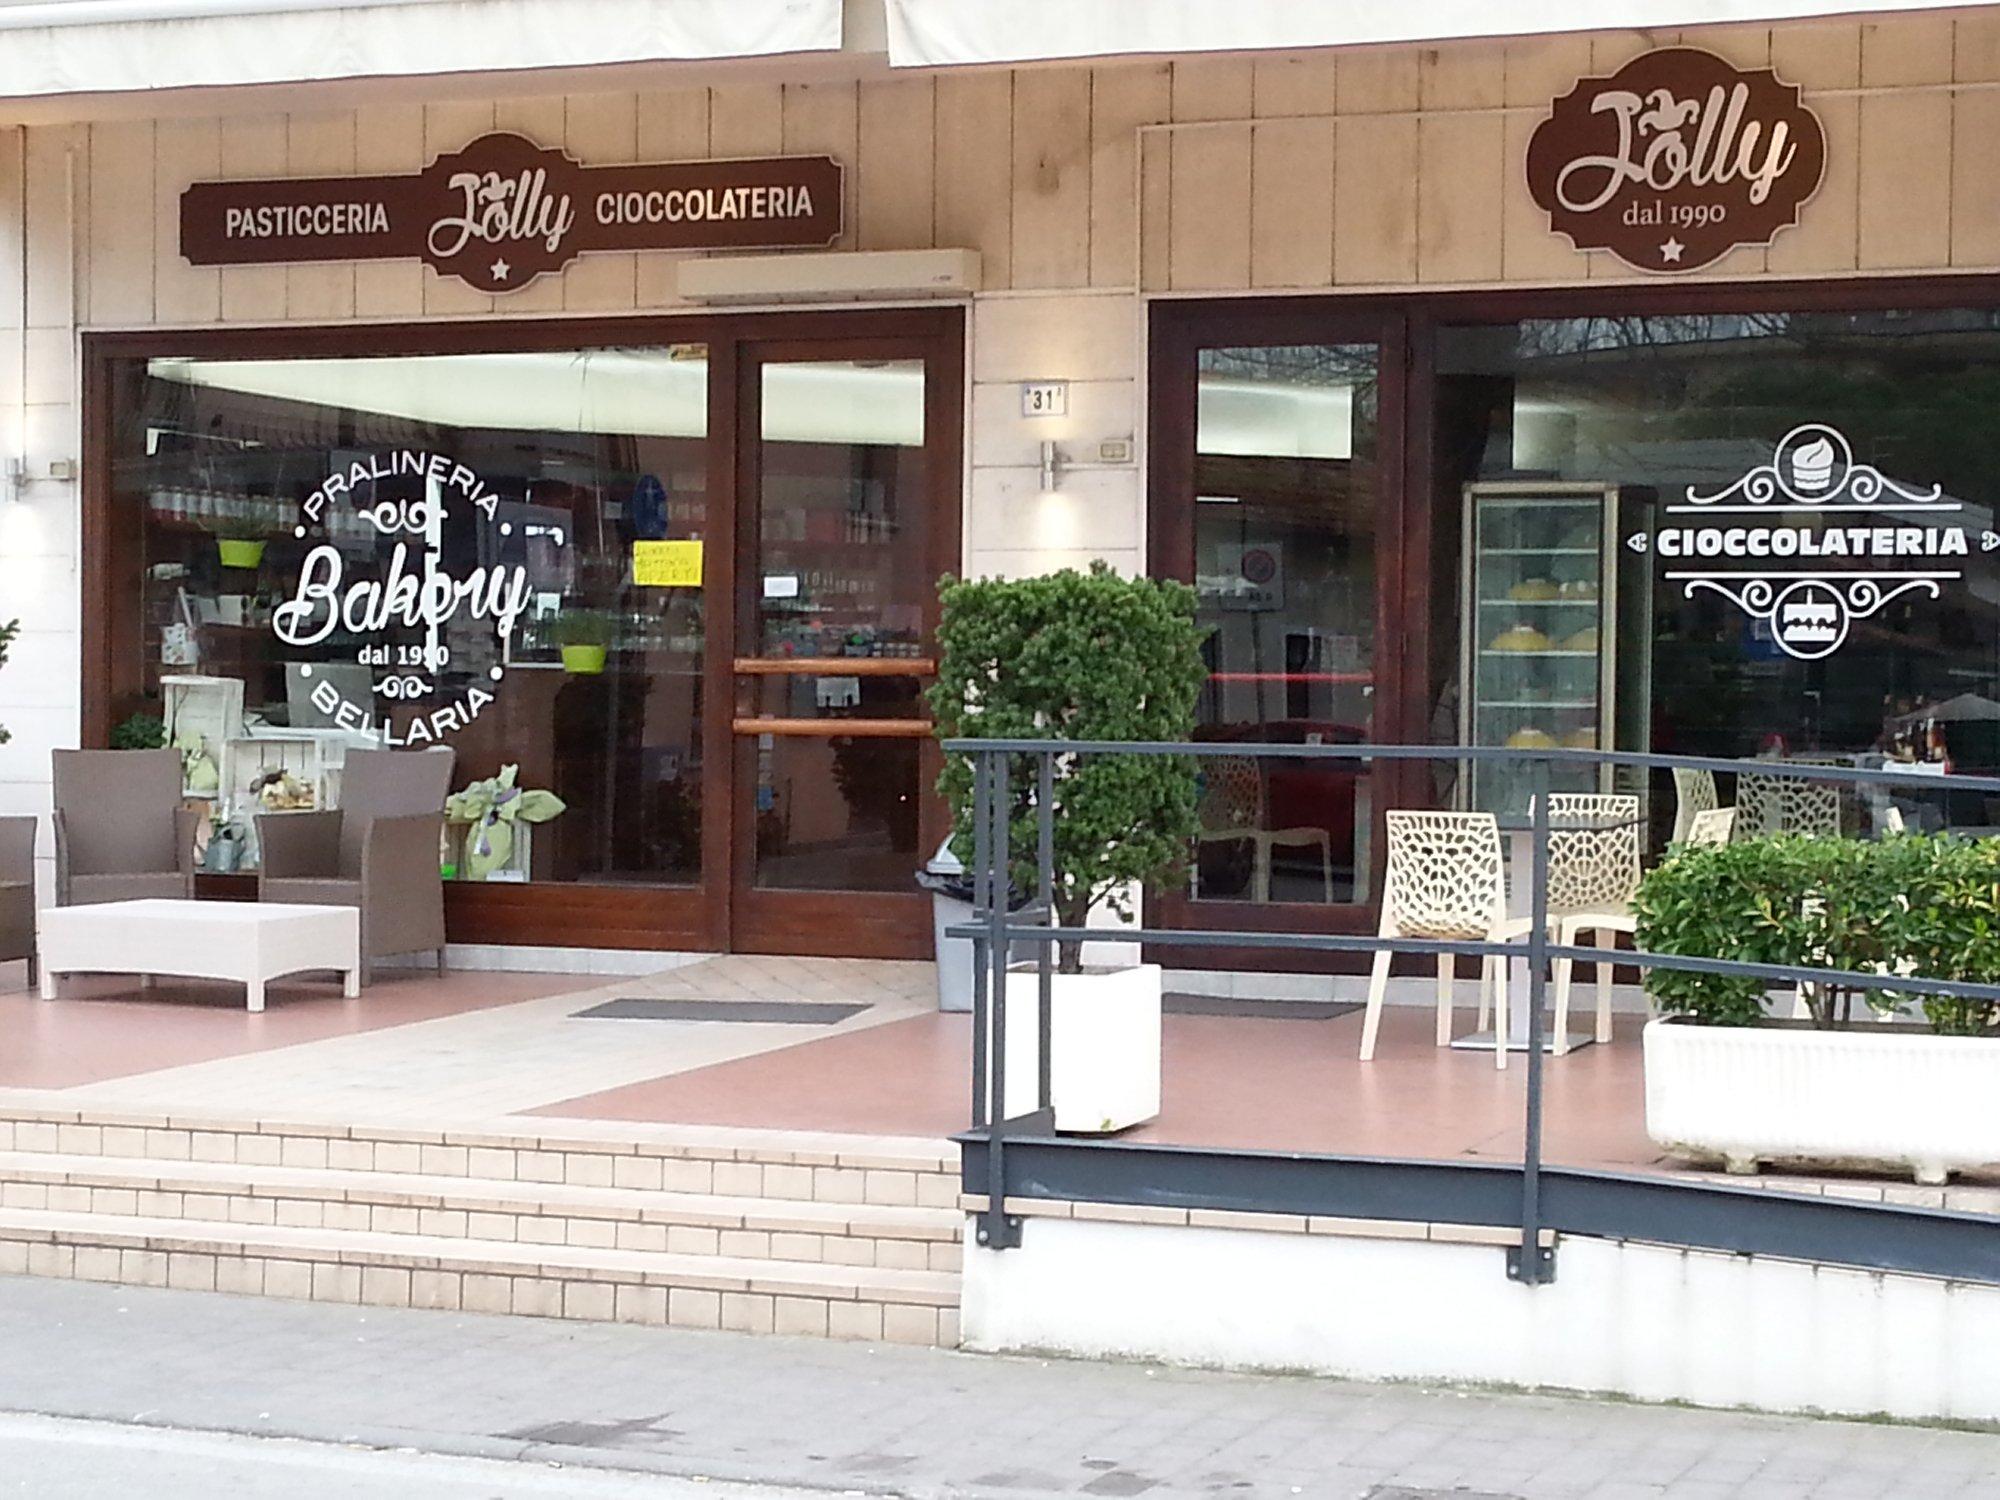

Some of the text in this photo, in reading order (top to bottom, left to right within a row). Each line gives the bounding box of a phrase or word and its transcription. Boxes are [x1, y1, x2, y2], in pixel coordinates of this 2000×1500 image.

[1555, 82, 1798, 212] Jolly
[226, 202, 390, 239] PASTICCERIA
[427, 166, 574, 258] Jolly
[595, 185, 814, 226] CIOCCOLATERIA
[1622, 200, 1727, 229] dal 1990
[1033, 389, 1053, 410] 31
[303, 450, 499, 523] PRALINERIA
[1657, 527, 1969, 557] CIOCCOLATERIA
[272, 542, 533, 647] Bakery
[357, 642, 390, 666] dal
[309, 680, 495, 746] BELLARIA
